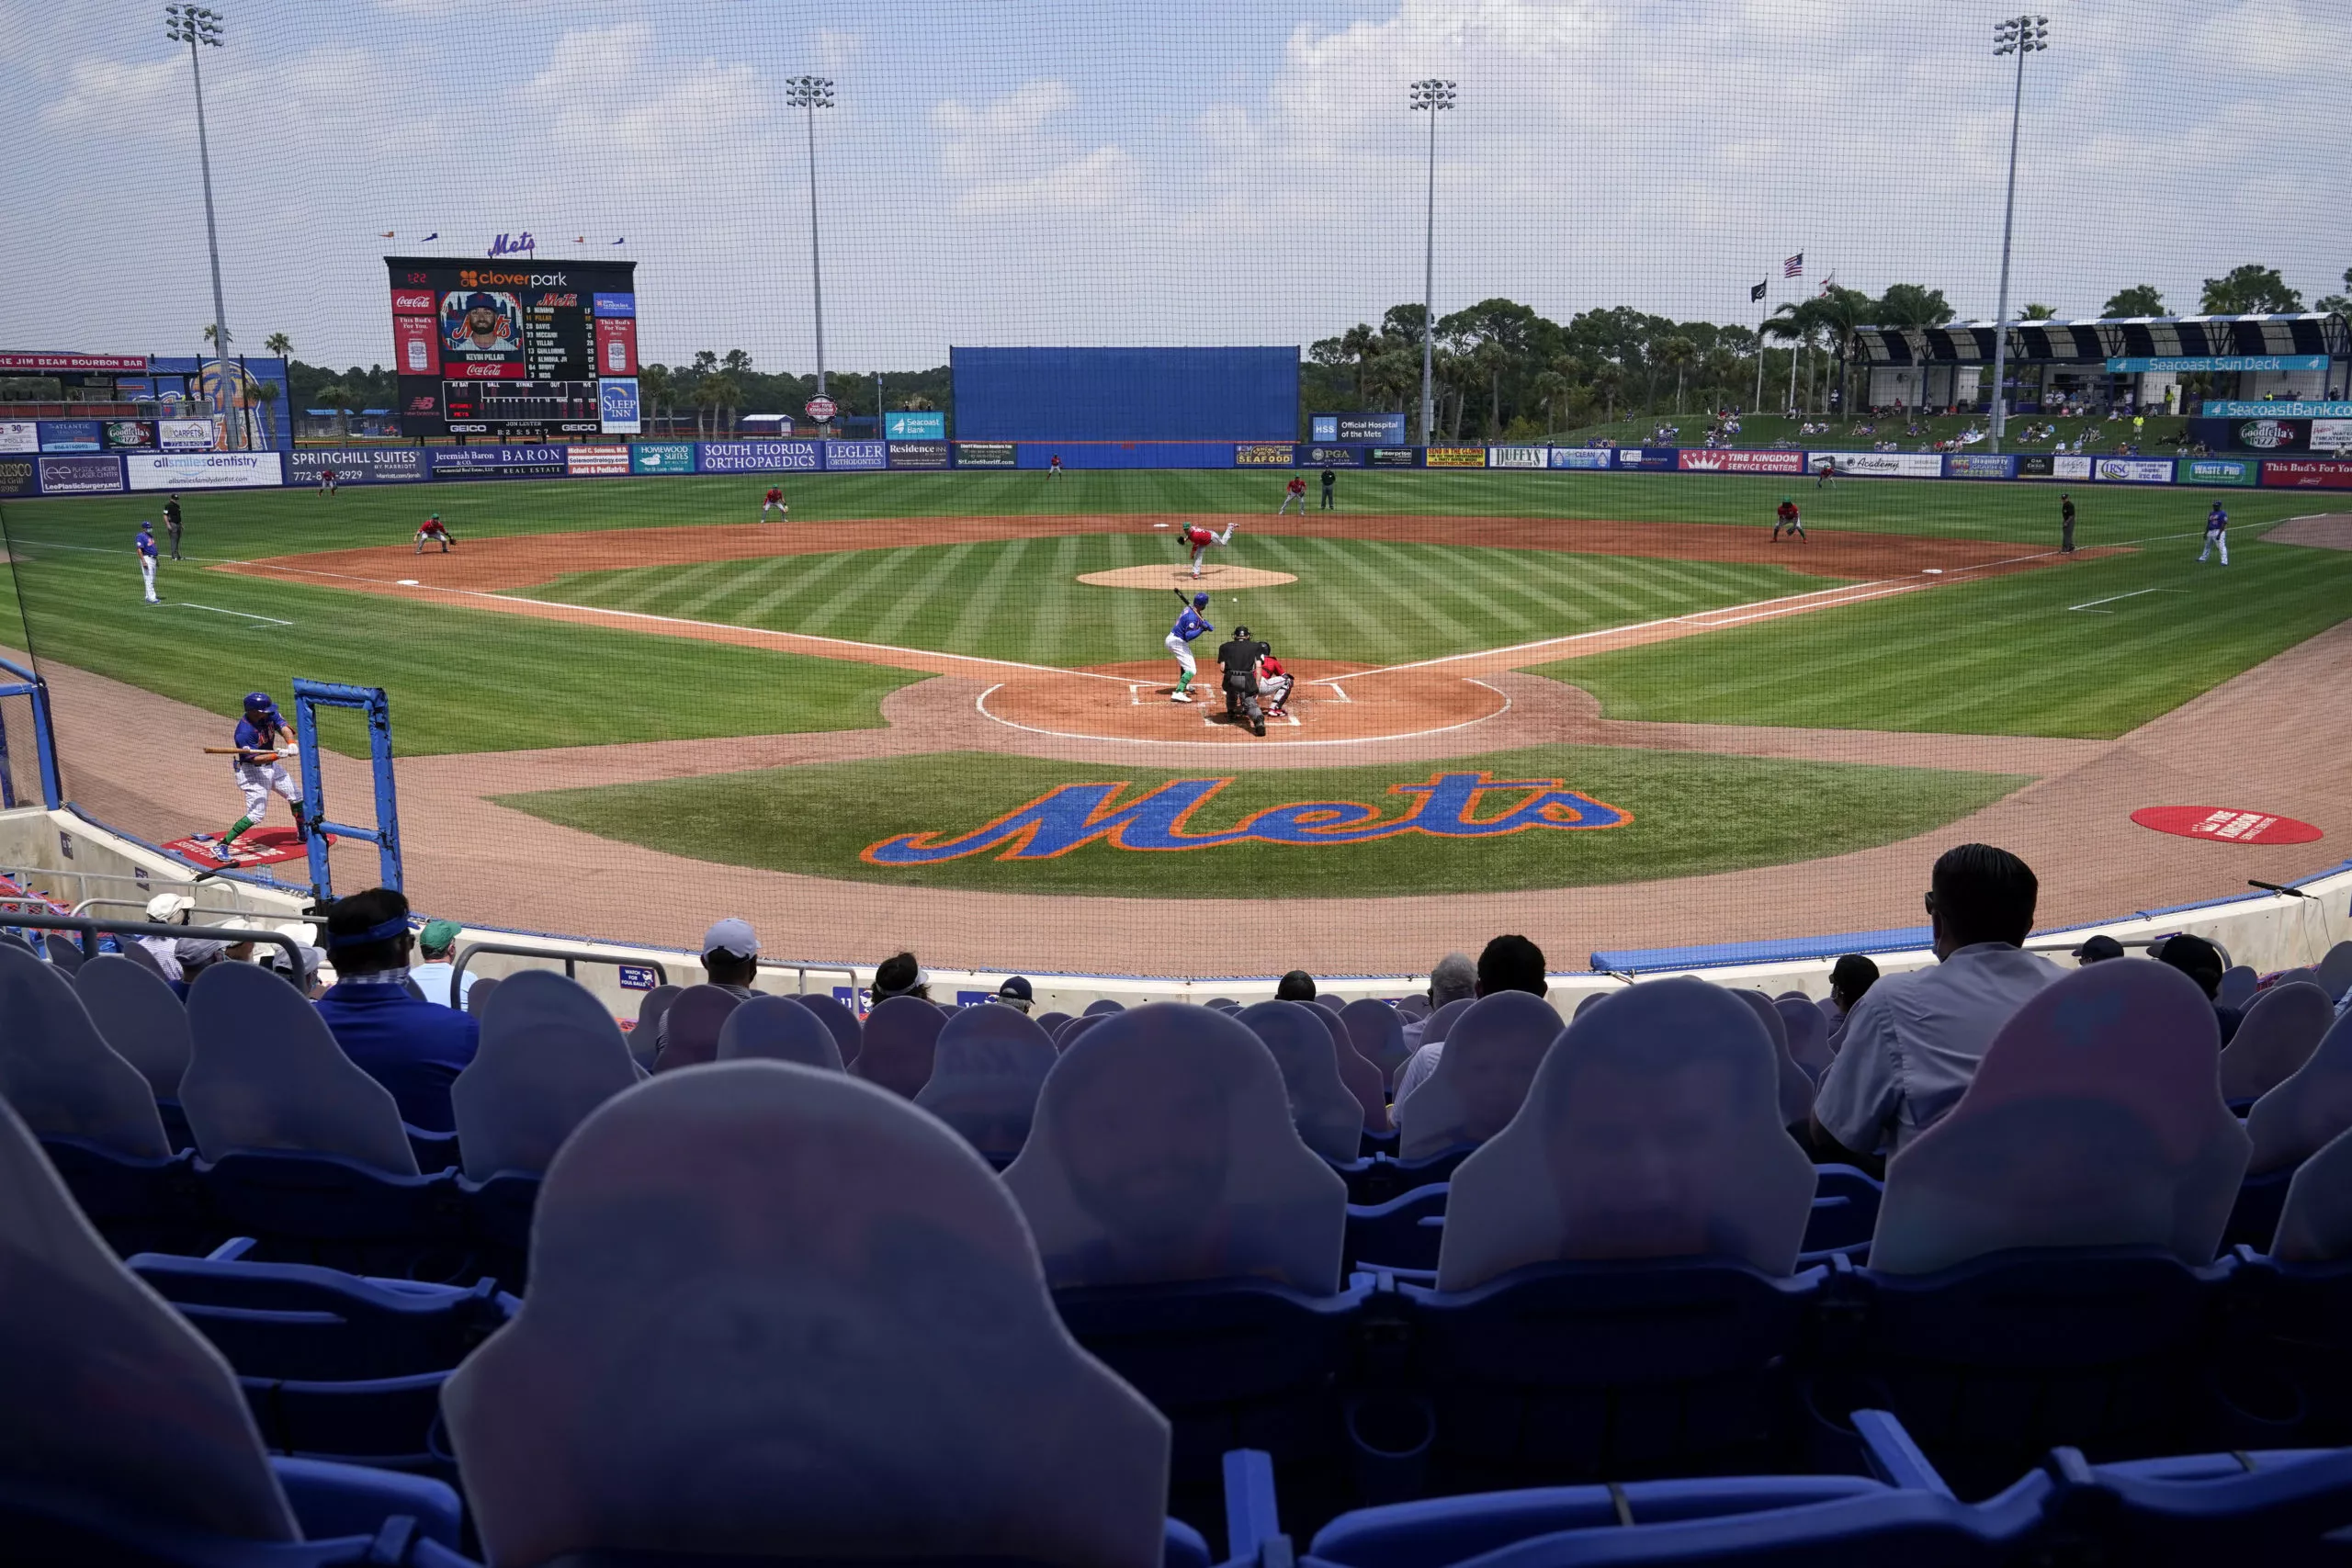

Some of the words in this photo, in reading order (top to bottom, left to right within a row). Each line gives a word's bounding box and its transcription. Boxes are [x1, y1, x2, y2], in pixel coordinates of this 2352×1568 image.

[488, 231, 535, 256] Mets
[537, 293, 577, 307] Mets
[452, 314, 511, 339] Mts
[2149, 358, 2211, 371] Seacoast
[2214, 357, 2242, 370] Sun
[2245, 357, 2279, 370] Deck
[604, 396, 636, 412] SLEEP
[1316, 425, 1335, 434] HSS
[1369, 422, 1398, 431] Hospital
[2241, 426, 2294, 439] Goodfella's
[2249, 437, 2281, 446] PIZZA
[502, 449, 560, 461] BARON
[705, 445, 751, 456] SOUTH
[757, 444, 814, 455] FLORIDA
[828, 446, 883, 458] LEGLER
[890, 445, 935, 453] Residence
[1324, 450, 1350, 458] PGA
[153, 456, 258, 468] allsmilesdentistry
[292, 452, 370, 465] SPRINGHILL
[374, 451, 416, 463] SUITES
[435, 451, 470, 462] Jeremiah
[471, 451, 494, 459] Baron
[706, 456, 815, 468] ORTHOPAEDICS
[1728, 453, 1750, 461] TIRE
[1753, 454, 1799, 463] KINGDOM
[1762, 464, 1797, 472] CENTERS
[1858, 457, 1900, 470] Academy
[2106, 463, 2130, 474] IRSC
[2267, 463, 2288, 471] This
[2290, 463, 2316, 472] Bud's
[2318, 464, 2335, 472] For
[294, 470, 362, 481] 772-8-2929
[2194, 465, 2221, 475] WASTE
[2223, 465, 2240, 476] PRO
[859, 771, 1634, 866] Mets
[841, 998, 852, 1009] 11
